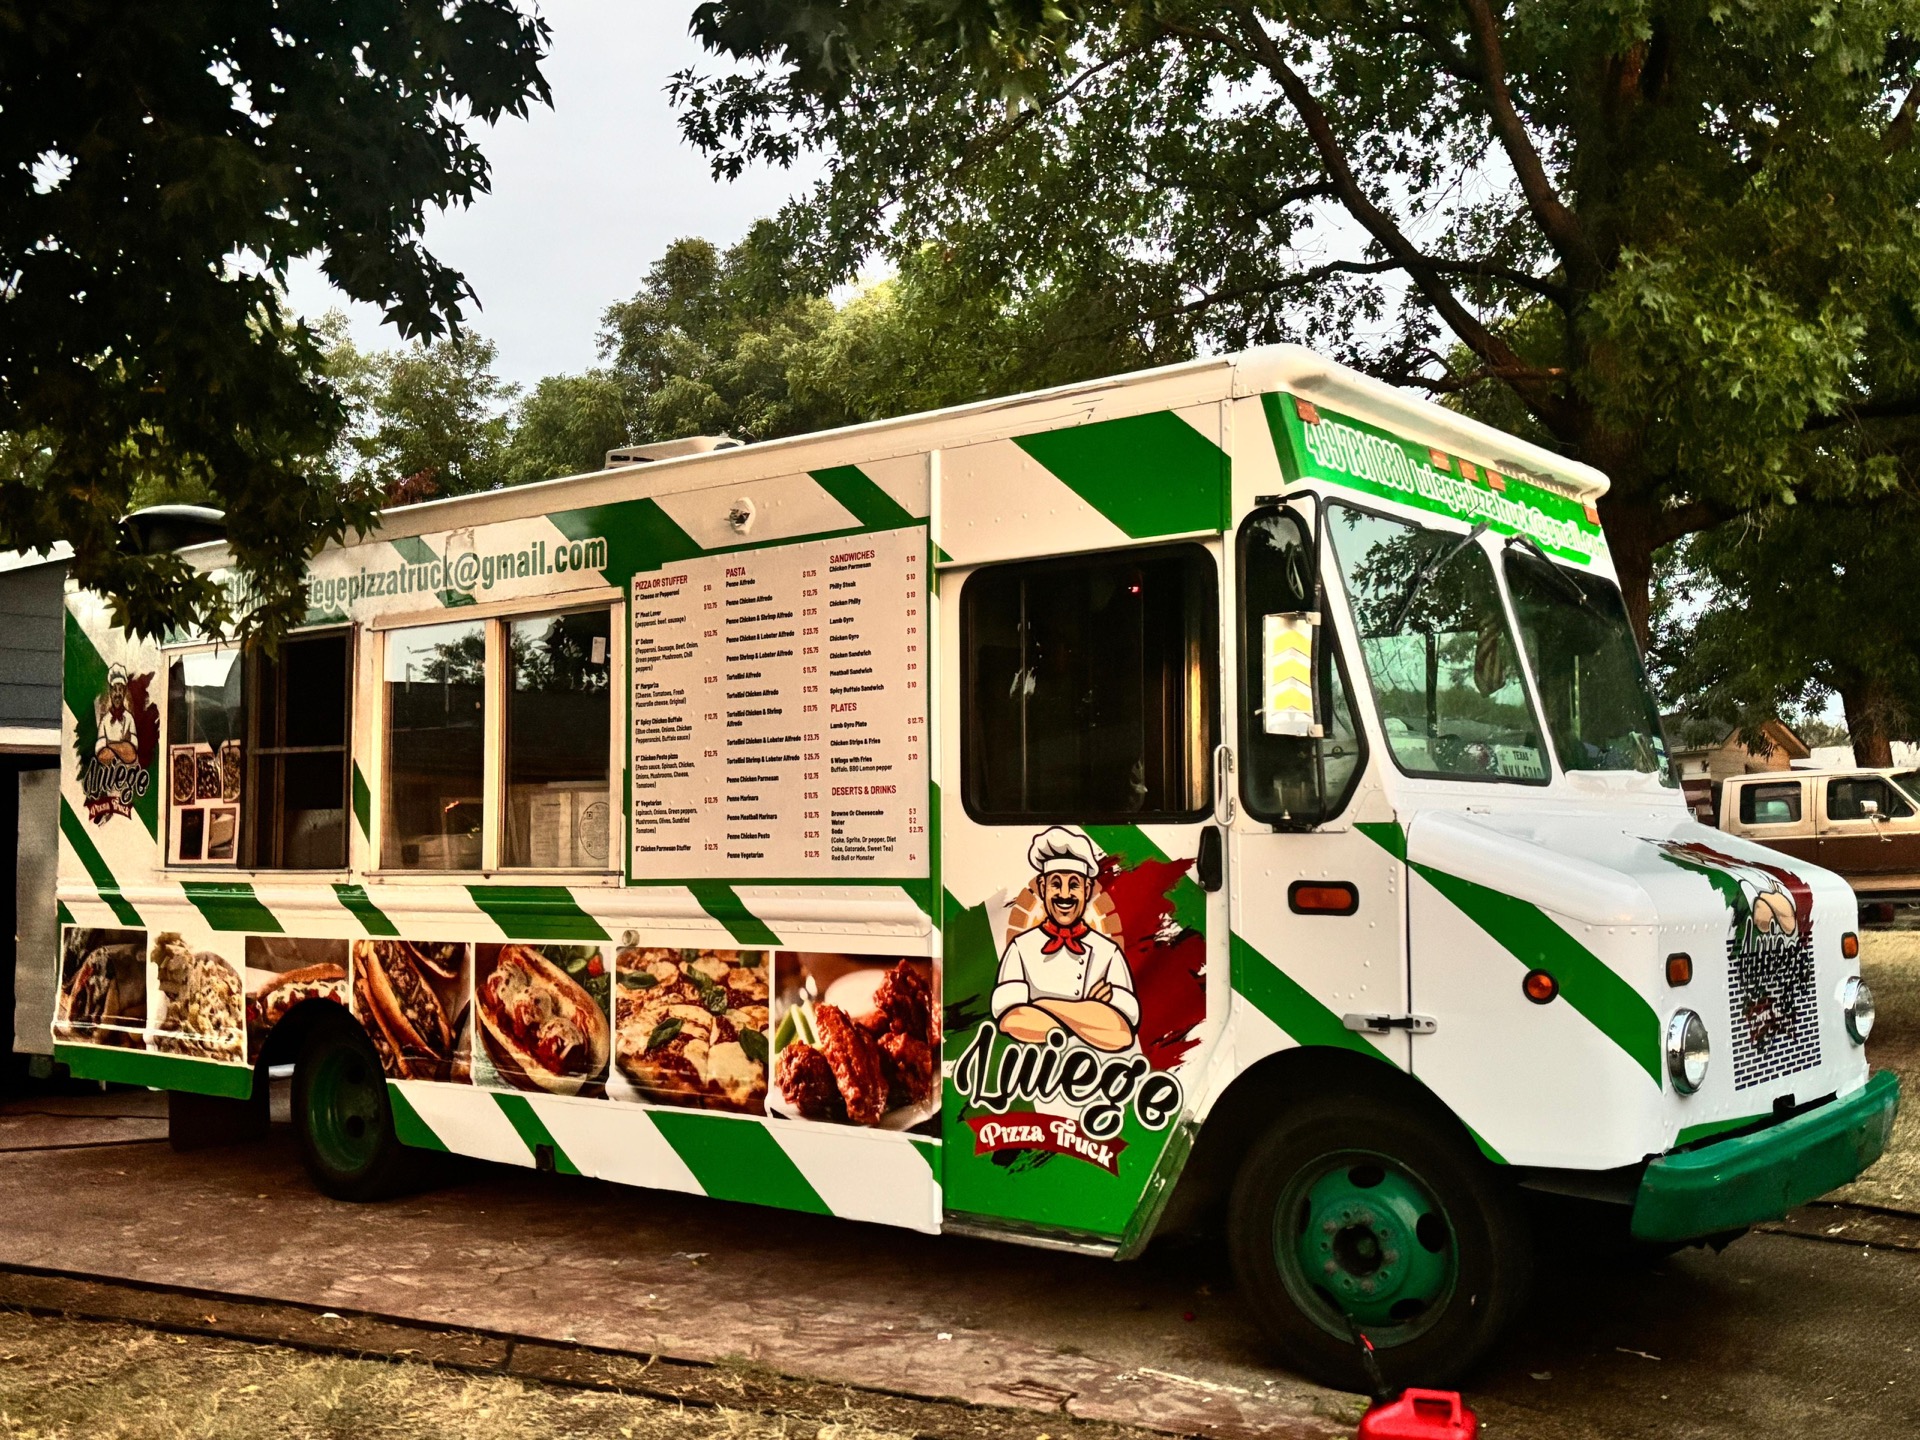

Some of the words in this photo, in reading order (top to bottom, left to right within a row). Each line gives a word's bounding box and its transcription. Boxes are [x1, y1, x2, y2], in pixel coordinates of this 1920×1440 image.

[830, 550, 875, 564] SANDWICHES
[310, 538, 606, 611] egepizzatruck@gmail.com
[726, 566, 745, 578] PASTA
[636, 580, 651, 590] PIZZA
[653, 579, 661, 588] OR
[662, 575, 688, 586] STUFFER
[740, 578, 755, 586] Alfredo
[829, 582, 842, 590] Philly
[739, 597, 756, 605] Chicken
[848, 598, 861, 606] Philly
[739, 615, 756, 623] Chicken
[761, 613, 776, 621] Shrimp
[777, 611, 793, 619] Alfredo
[739, 634, 756, 642] Chicken
[778, 630, 794, 638] Alfredo
[830, 634, 848, 642] Chicken
[740, 653, 755, 661] Shrimp
[850, 667, 873, 675] Sandwich
[745, 690, 762, 698] Chicken
[831, 702, 857, 713] PLATES
[83, 757, 150, 804] Luiege
[832, 786, 863, 796] DESERTS
[864, 786, 869, 795] &
[871, 785, 896, 794] DRINKS
[955, 1022, 1182, 1139] Luiege
[979, 1122, 1045, 1147] Pizza
[1050, 1120, 1114, 1168] Truck
